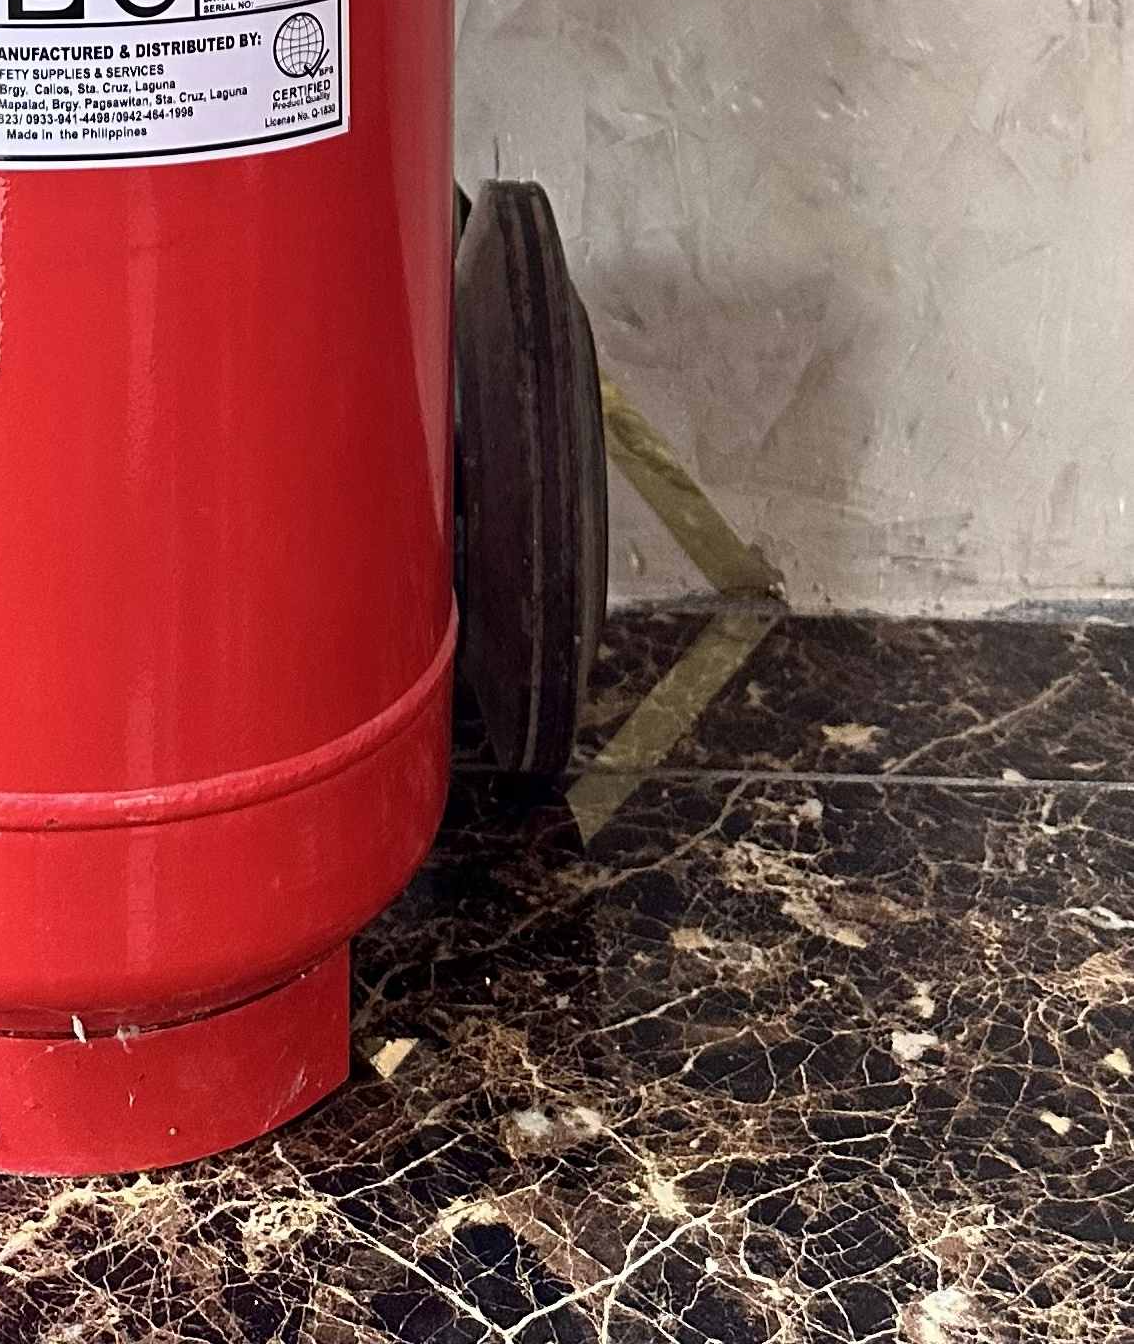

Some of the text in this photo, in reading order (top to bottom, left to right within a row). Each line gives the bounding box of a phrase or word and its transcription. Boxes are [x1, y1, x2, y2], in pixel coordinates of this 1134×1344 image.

[119, 44, 130, 58] &
[136, 35, 235, 58] DISTRIBUTED
[239, 31, 261, 48] BY:
[32, 67, 90, 80] SUPPLIES
[94, 68, 102, 78] &
[106, 64, 164, 78] SERVICES
[135, 79, 176, 93] Laguna
[273, 79, 331, 102] CERTIFIED
[0, 99, 48, 112] Mapalad,
[210, 85, 248, 102] Laguna
[265, 115, 295, 128] License
[7, 127, 147, 140] Made the Philippines
